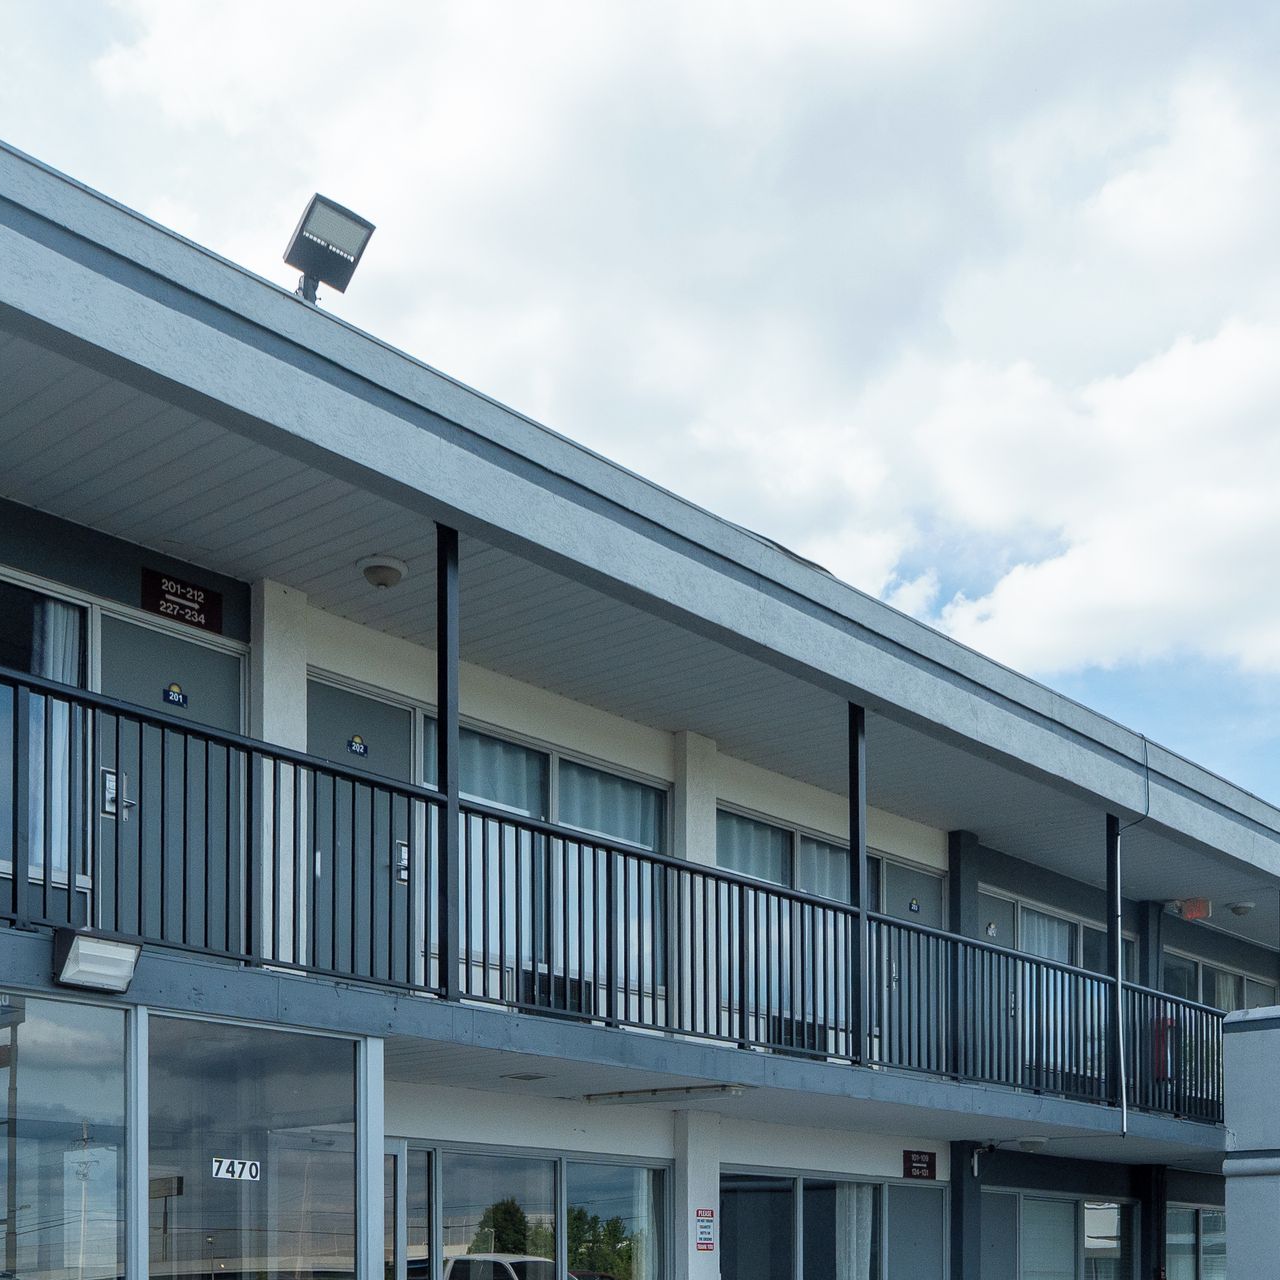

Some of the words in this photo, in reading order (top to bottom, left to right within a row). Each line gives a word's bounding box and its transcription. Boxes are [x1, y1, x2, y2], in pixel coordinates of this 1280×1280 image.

[161, 578, 205, 603] 201-212
[159, 600, 206, 625] 227-234
[169, 691, 183, 703] 201
[214, 1159, 259, 1179] 7470
